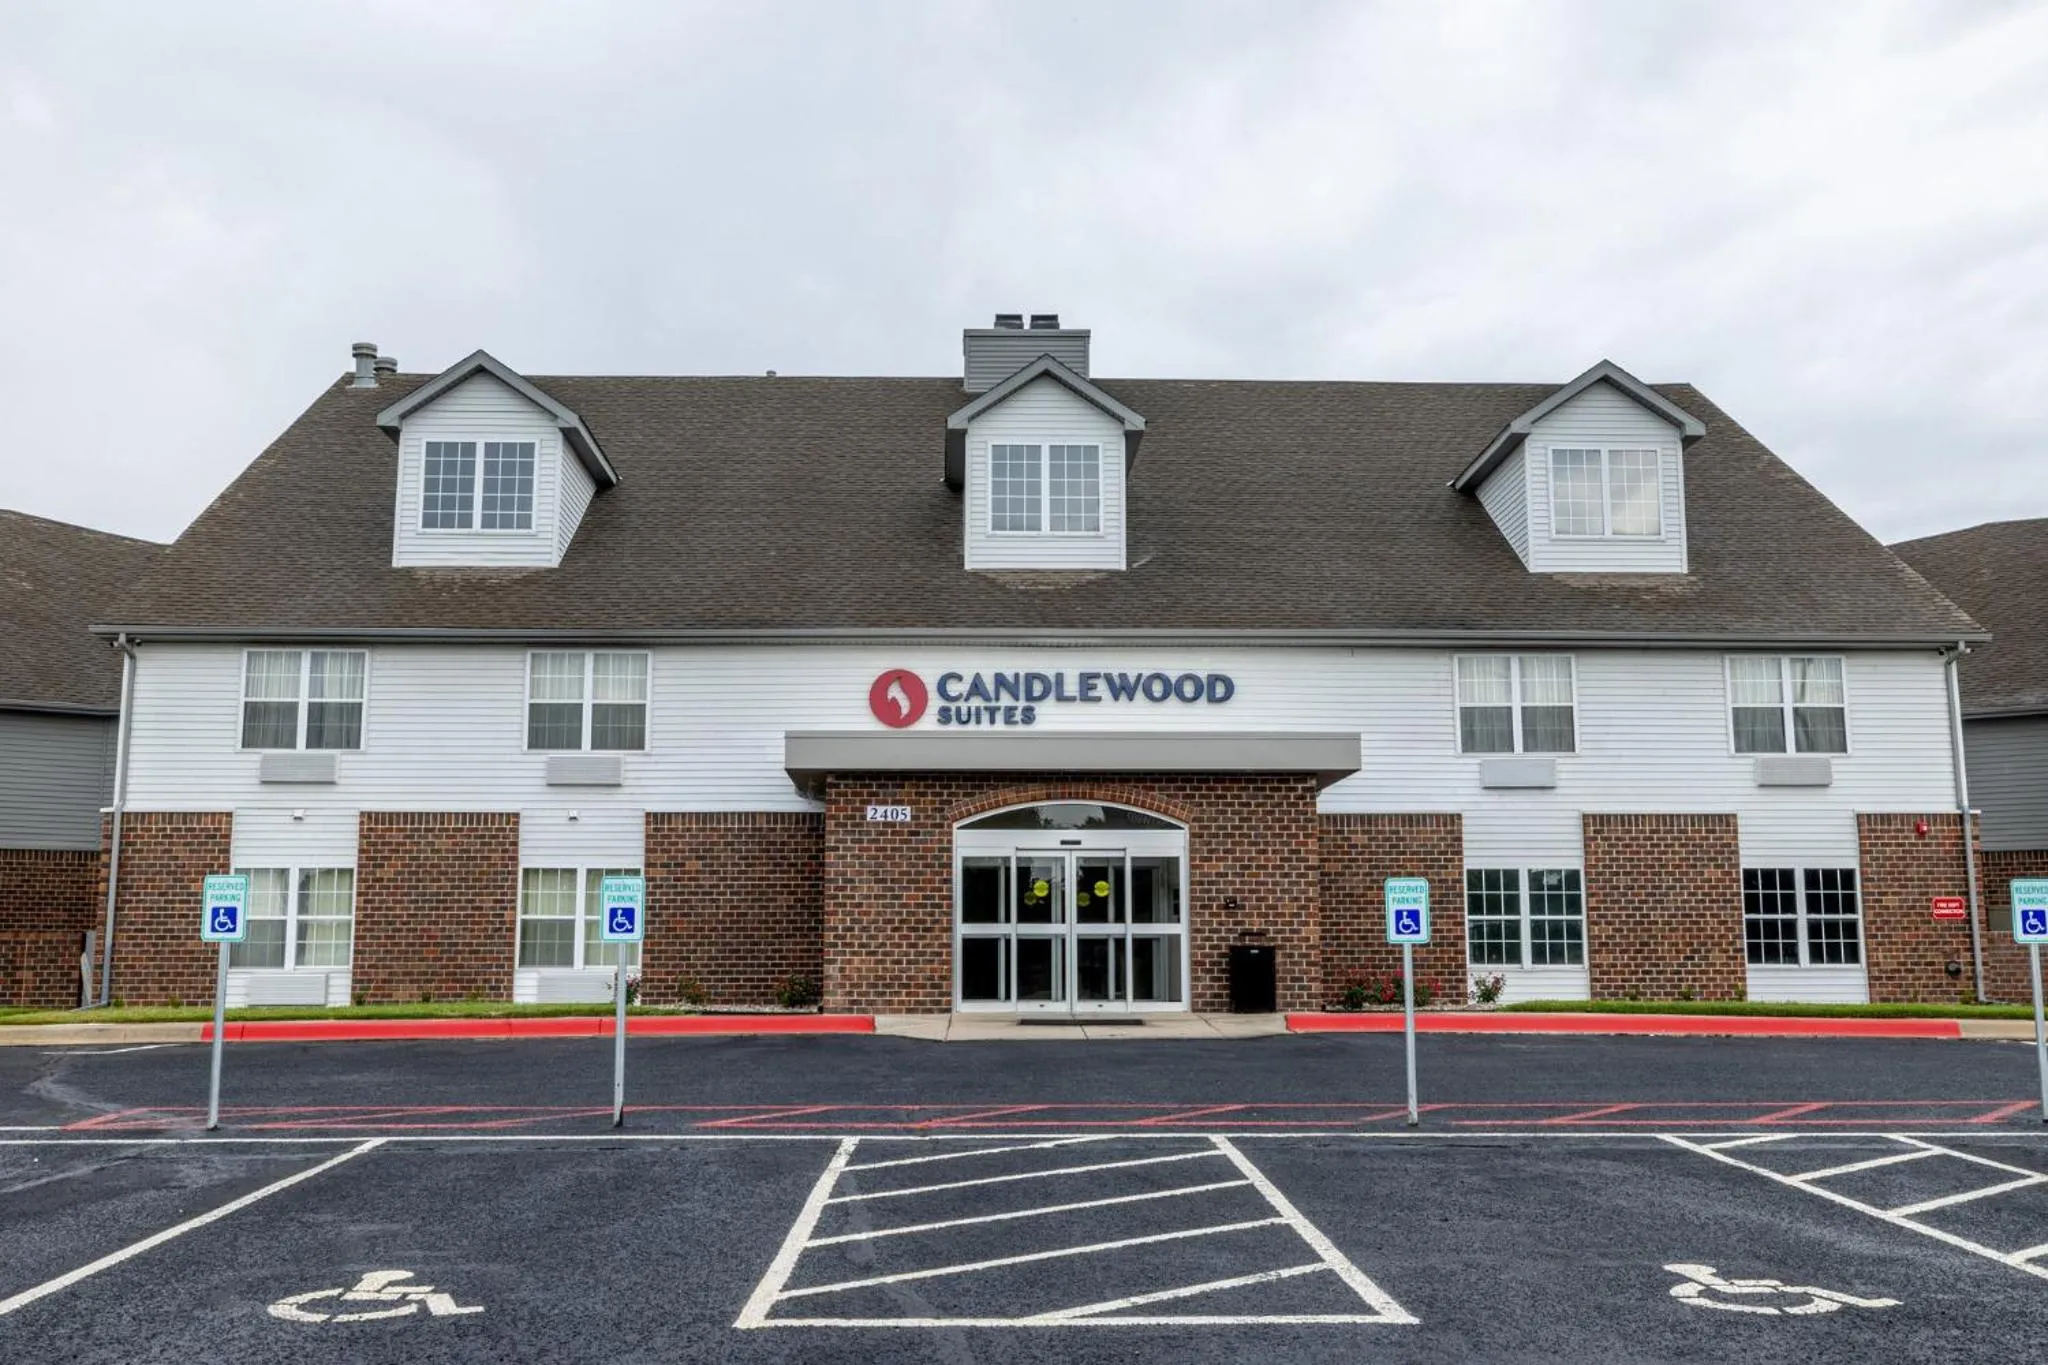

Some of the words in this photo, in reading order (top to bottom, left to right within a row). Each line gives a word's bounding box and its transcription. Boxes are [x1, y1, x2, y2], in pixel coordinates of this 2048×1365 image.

[937, 672, 1235, 704] CANDLEWOOD
[937, 705, 1037, 725] SUITES
[869, 807, 908, 821] 2405
[207, 882, 244, 890] RESERVED
[605, 884, 641, 892] RESERVED
[608, 895, 639, 903] PARKING
[1392, 897, 1424, 905] PARKING
